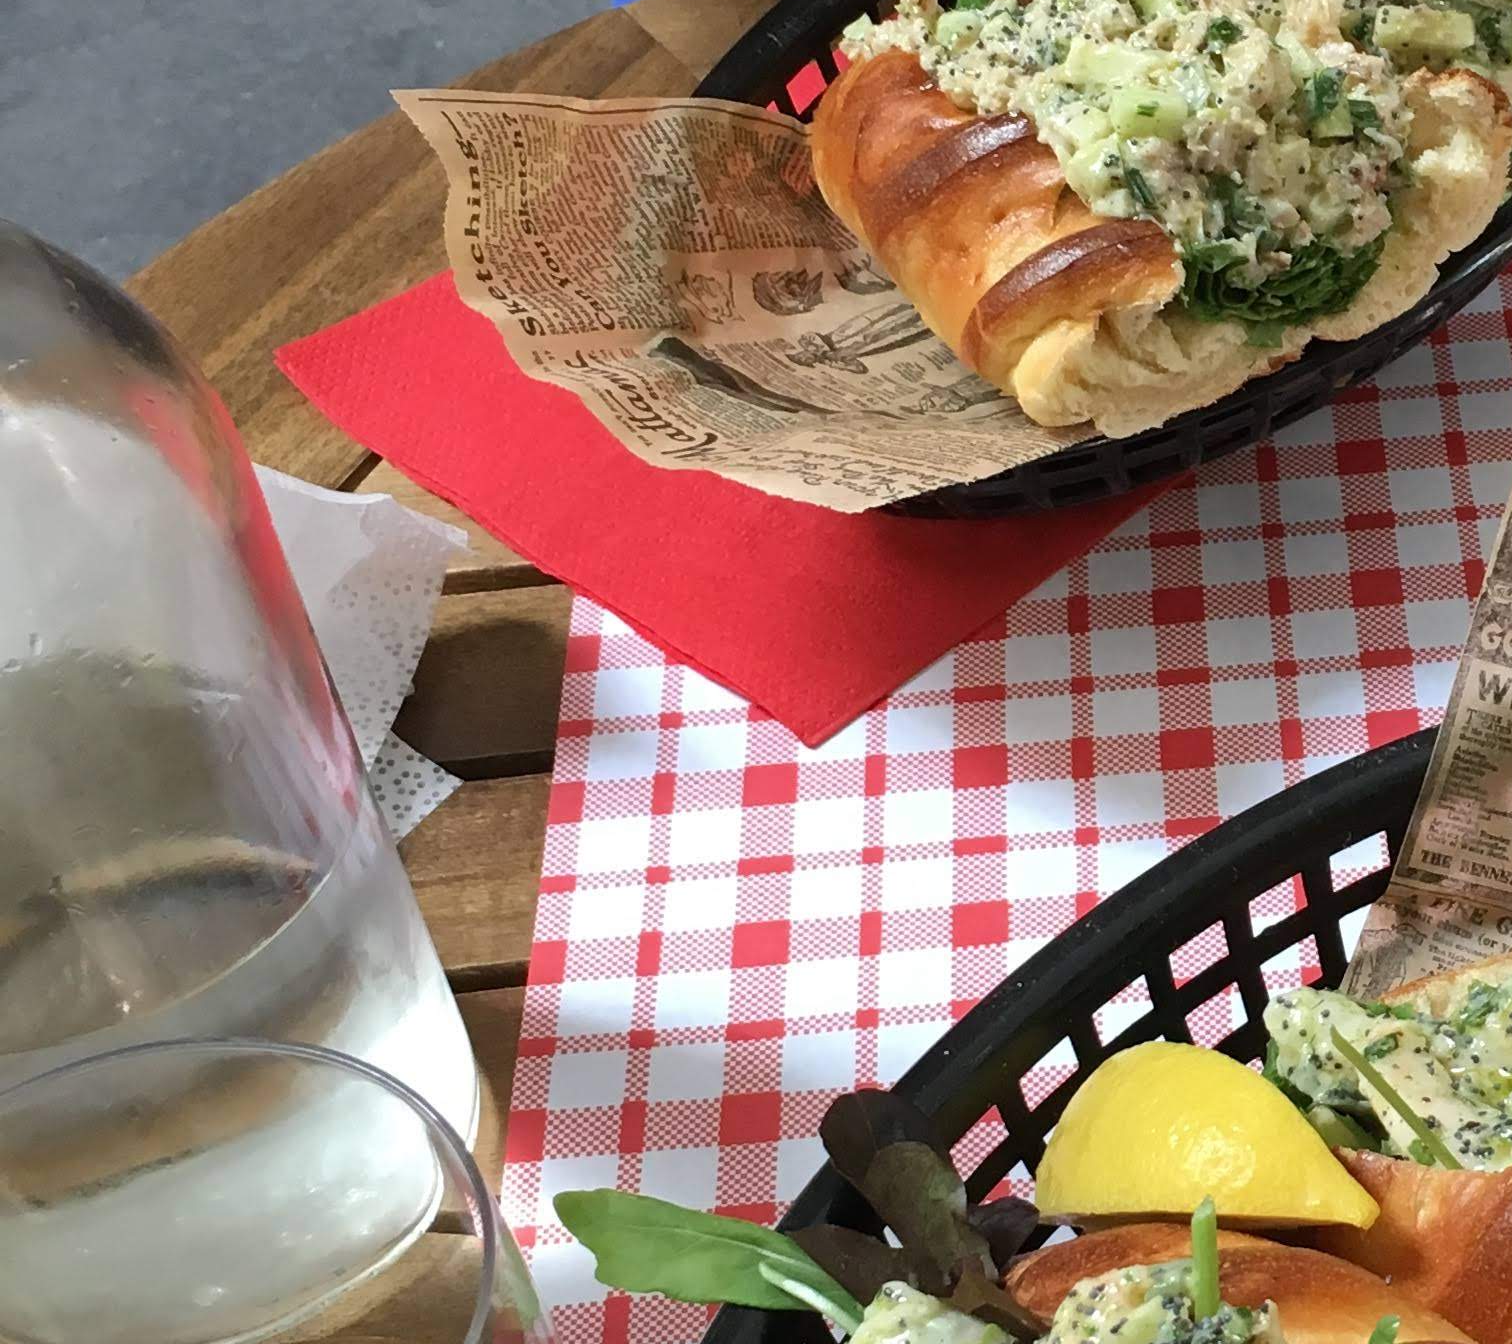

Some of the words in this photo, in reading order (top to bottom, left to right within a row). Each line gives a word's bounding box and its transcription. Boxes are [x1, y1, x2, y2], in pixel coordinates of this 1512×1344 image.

[532, 238, 571, 289] You
[574, 286, 617, 332] Can
[1419, 849, 1453, 869] THE
[1477, 932, 1498, 949] (or
